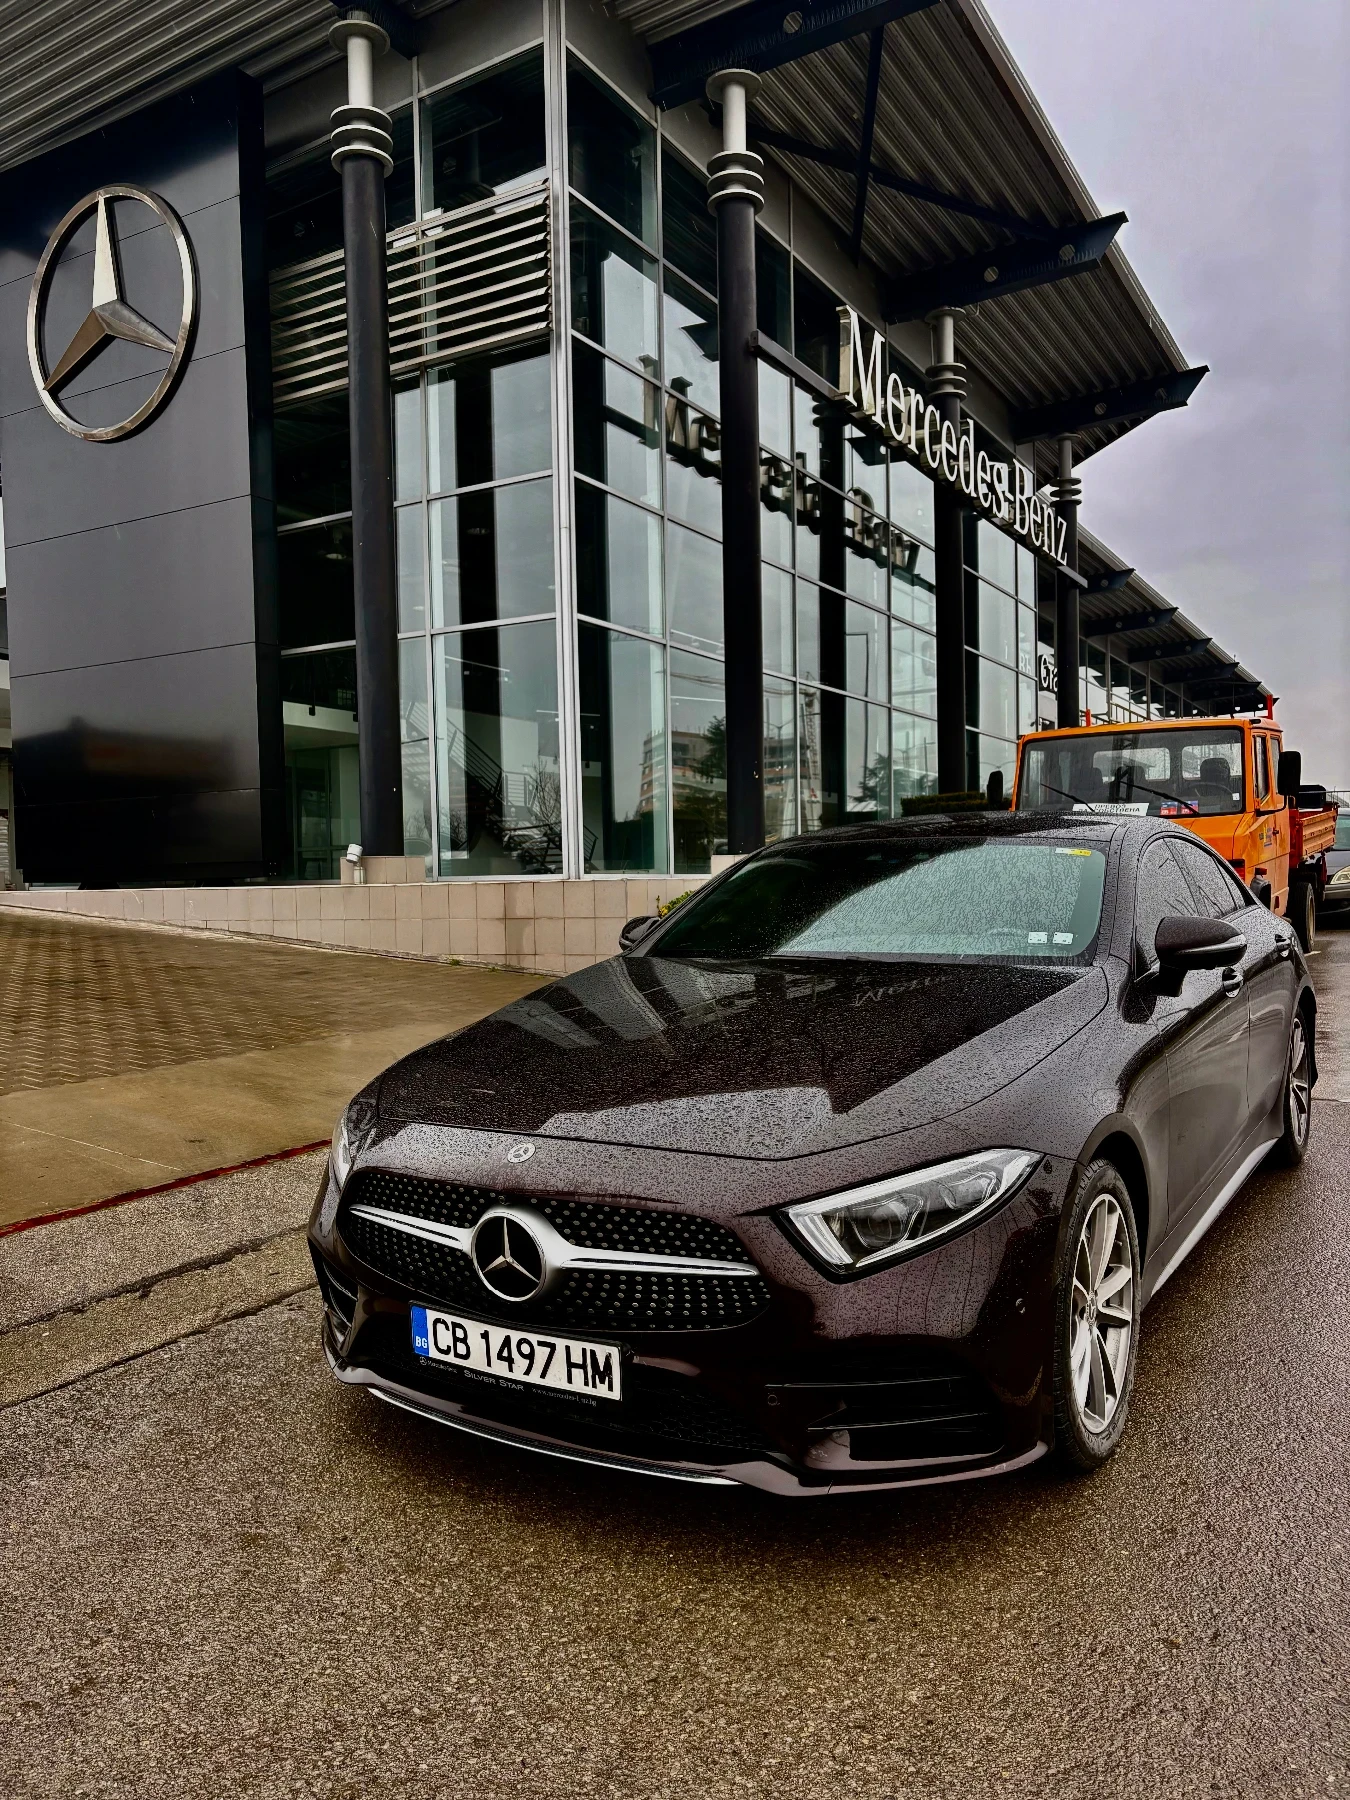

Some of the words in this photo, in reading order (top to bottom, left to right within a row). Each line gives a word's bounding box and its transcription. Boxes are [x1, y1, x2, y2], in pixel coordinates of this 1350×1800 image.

[837, 304, 1068, 567] Mercedes-Benz
[415, 1335, 428, 1348] BG
[432, 1317, 471, 1361] CB
[480, 1329, 557, 1379] 1497
[565, 1344, 614, 1392] HM
